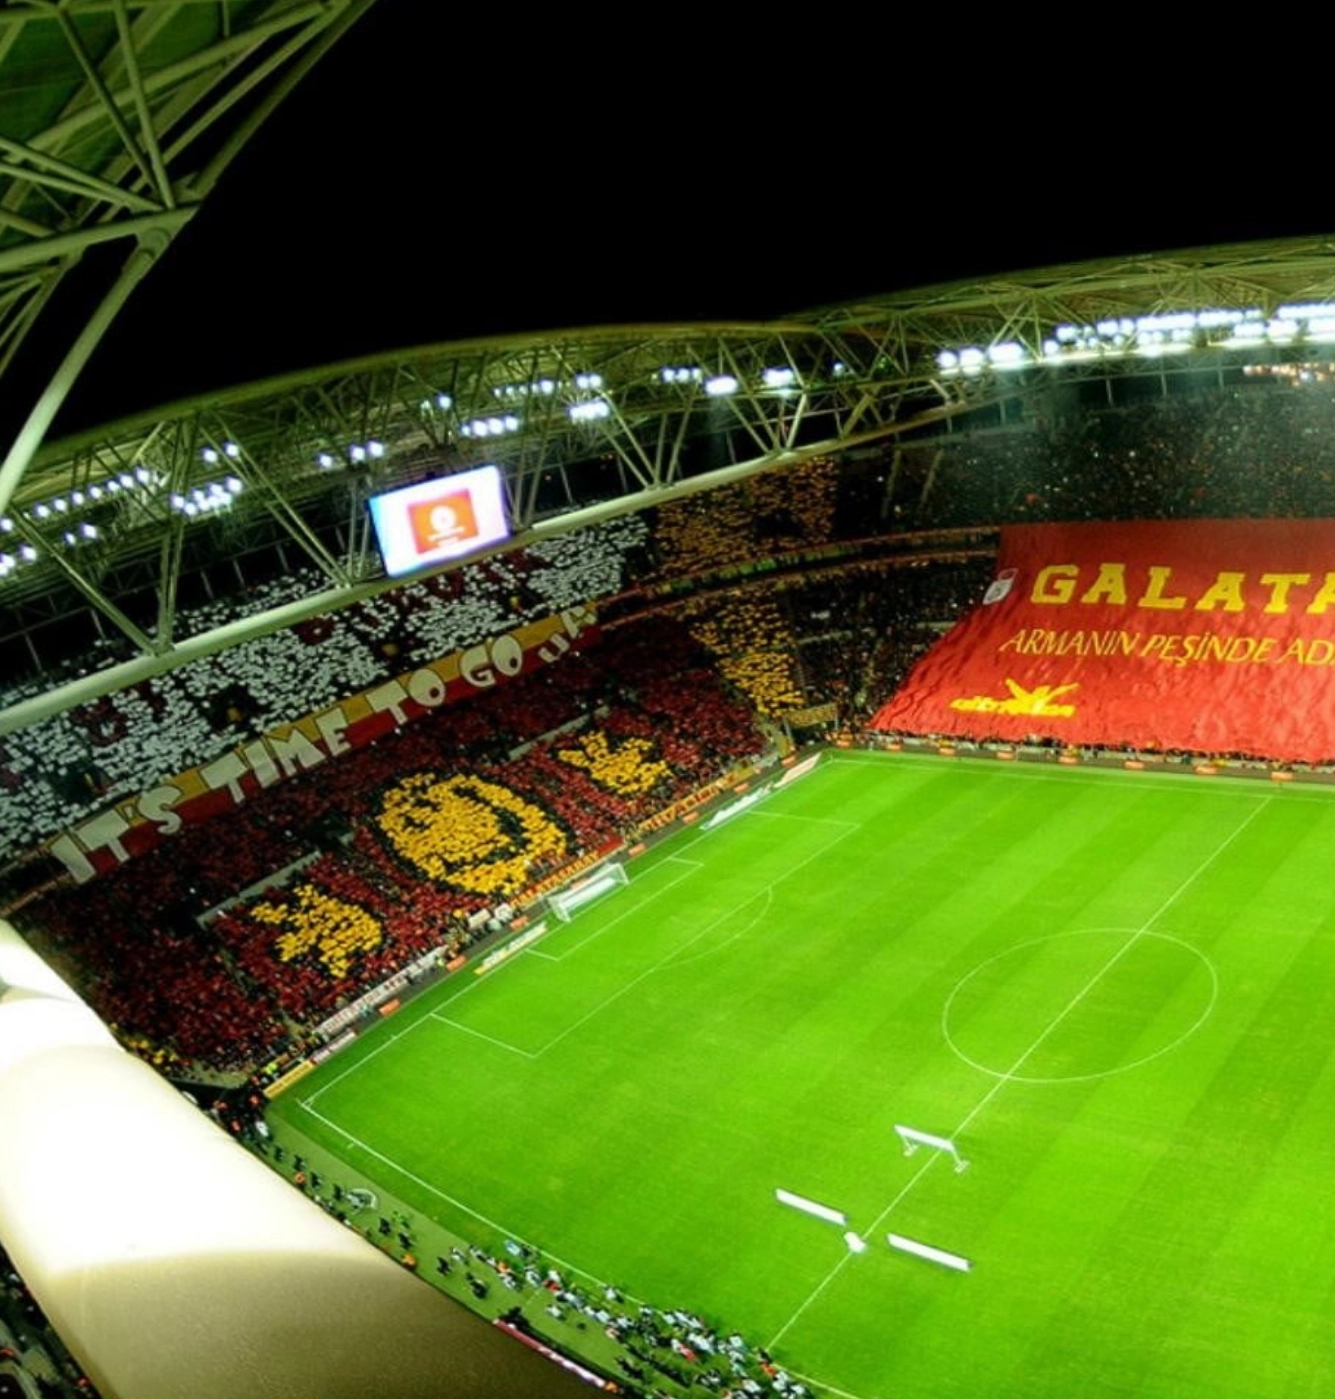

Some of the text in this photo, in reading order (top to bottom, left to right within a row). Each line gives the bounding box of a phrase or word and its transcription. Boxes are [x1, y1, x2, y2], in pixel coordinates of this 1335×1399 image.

[1000, 628, 1132, 657] ARMANIN
[1140, 632, 1278, 668] PEŞİNDE
[51, 785, 183, 885] IT'S
[200, 706, 352, 805] TIME
[366, 667, 446, 725] TO
[459, 633, 524, 688] GO
